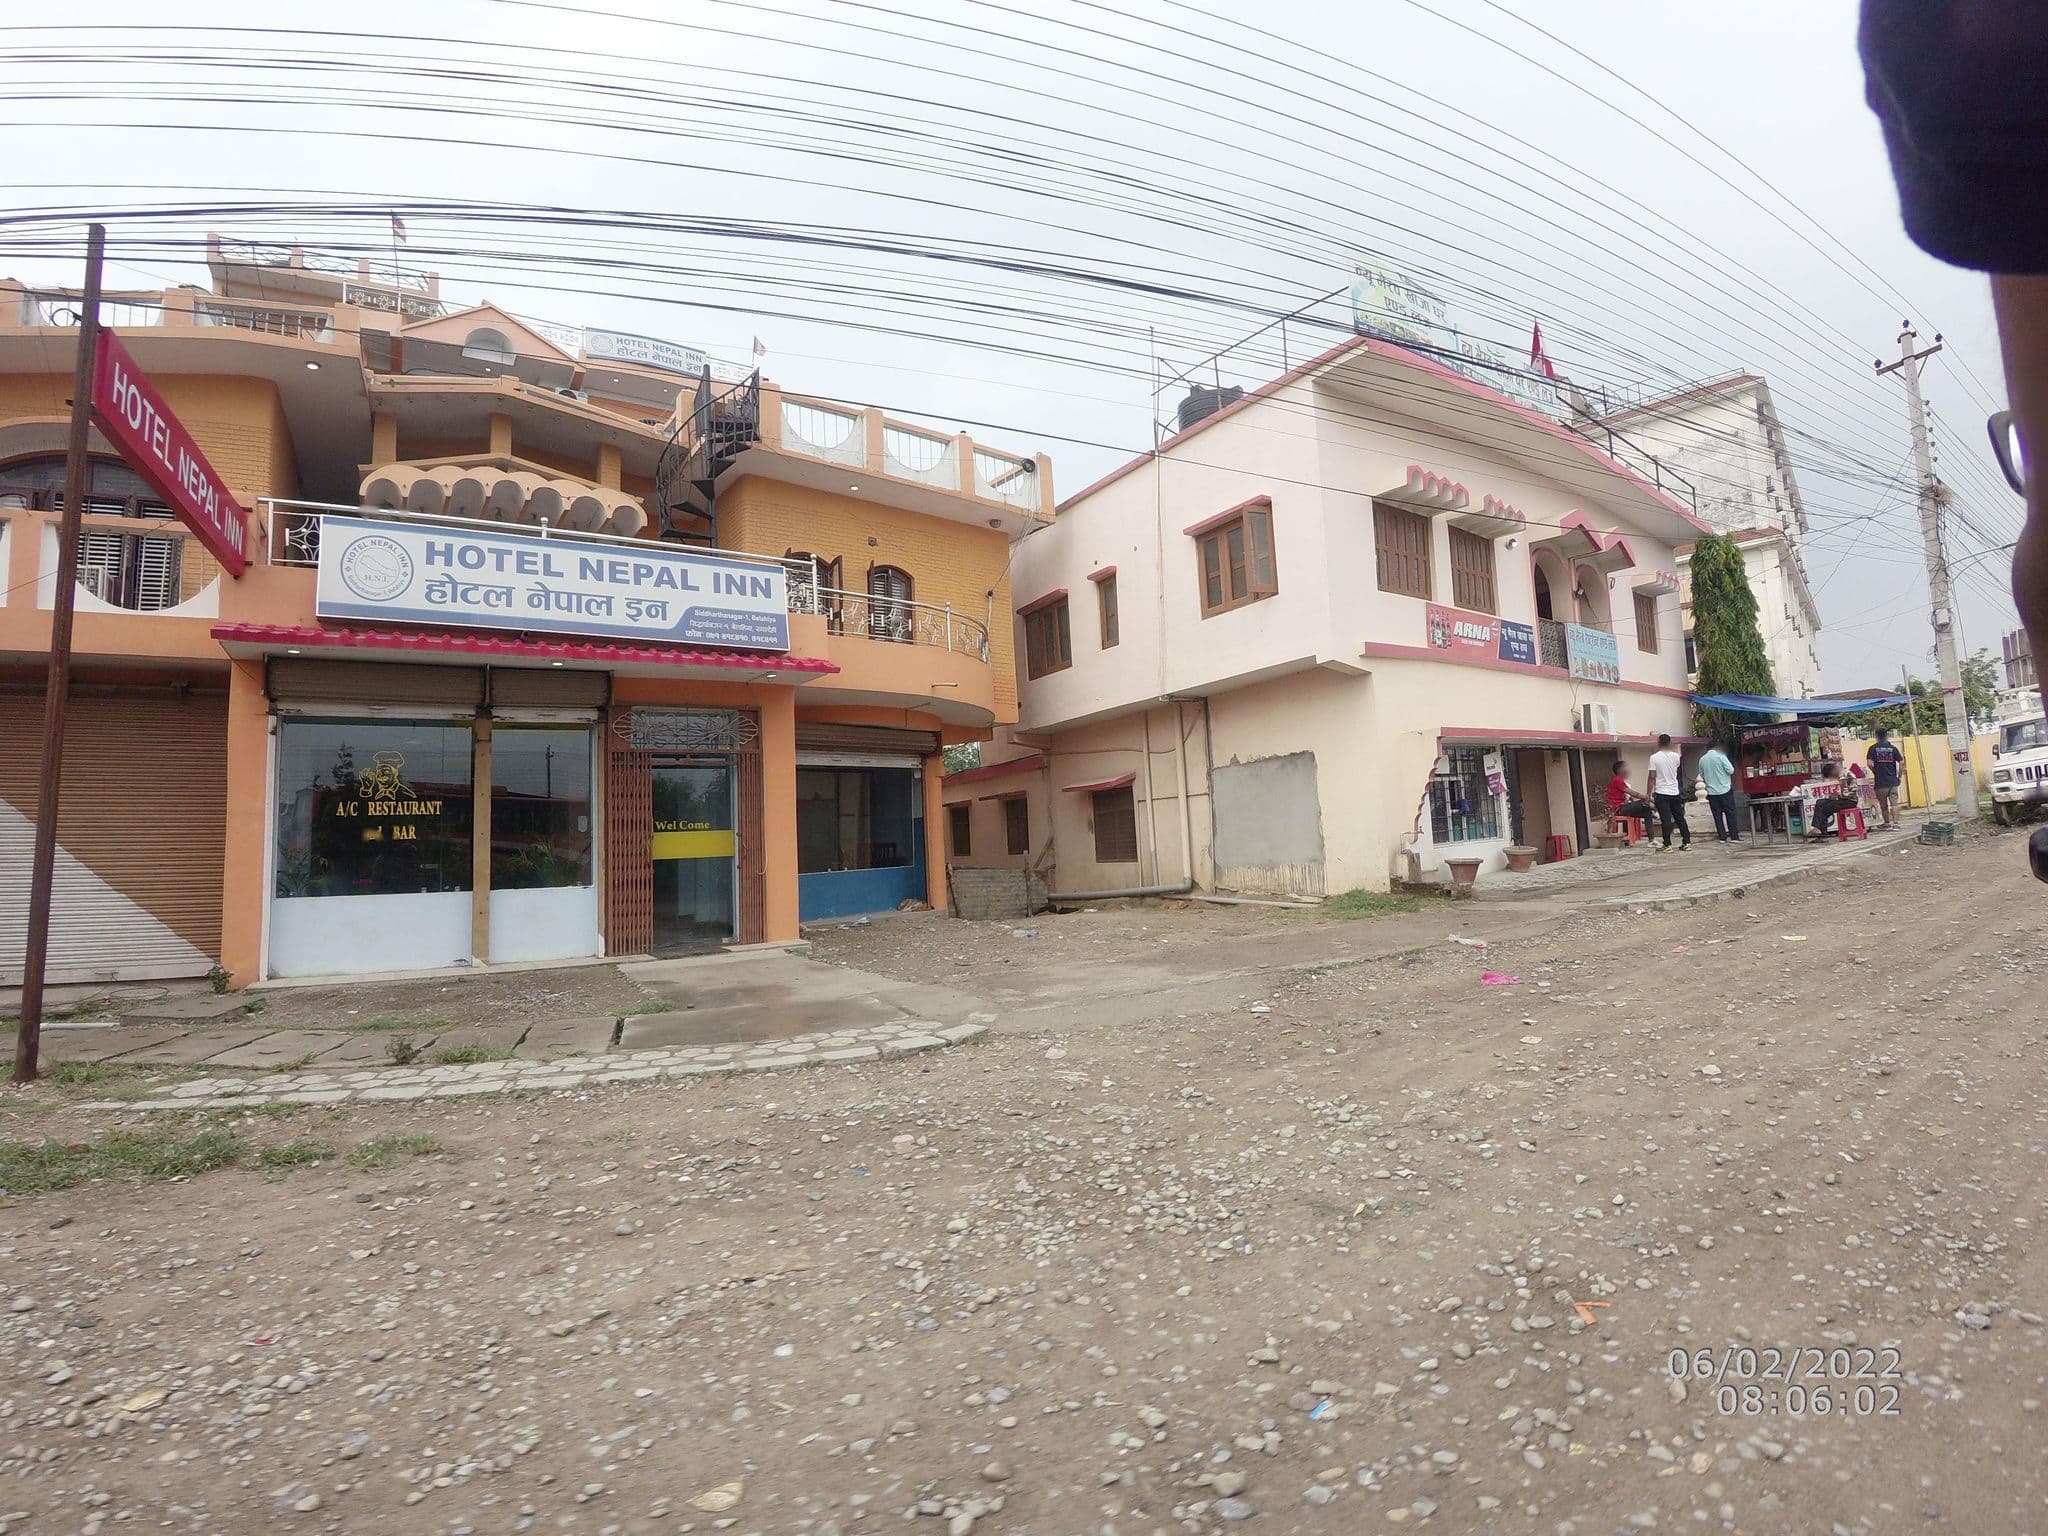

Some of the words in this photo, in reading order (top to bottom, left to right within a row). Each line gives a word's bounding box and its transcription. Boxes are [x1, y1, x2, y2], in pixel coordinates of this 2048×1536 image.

[616, 337, 649, 349] HOTEL
[652, 343, 682, 357] NEPAL
[685, 352, 703, 363] INN
[112, 361, 175, 473] HOTEL
[178, 446, 222, 531] NEPAL
[224, 506, 245, 556] INN
[345, 541, 369, 565] HOTEL
[370, 539, 399, 554] NEPAL
[397, 552, 409, 569] INN
[424, 540, 565, 578] HOTEL
[579, 556, 700, 592] NEPAL
[712, 570, 773, 599] INN
[424, 572, 515, 608] होटल
[526, 580, 614, 617] नेपाल
[625, 597, 670, 623] इन
[1453, 621, 1491, 642] ARNA
[336, 800, 359, 818] A/C
[367, 800, 443, 816] RESTAURANT
[392, 824, 417, 840] BAR
[654, 820, 677, 831] Wel
[679, 820, 711, 830] Come
